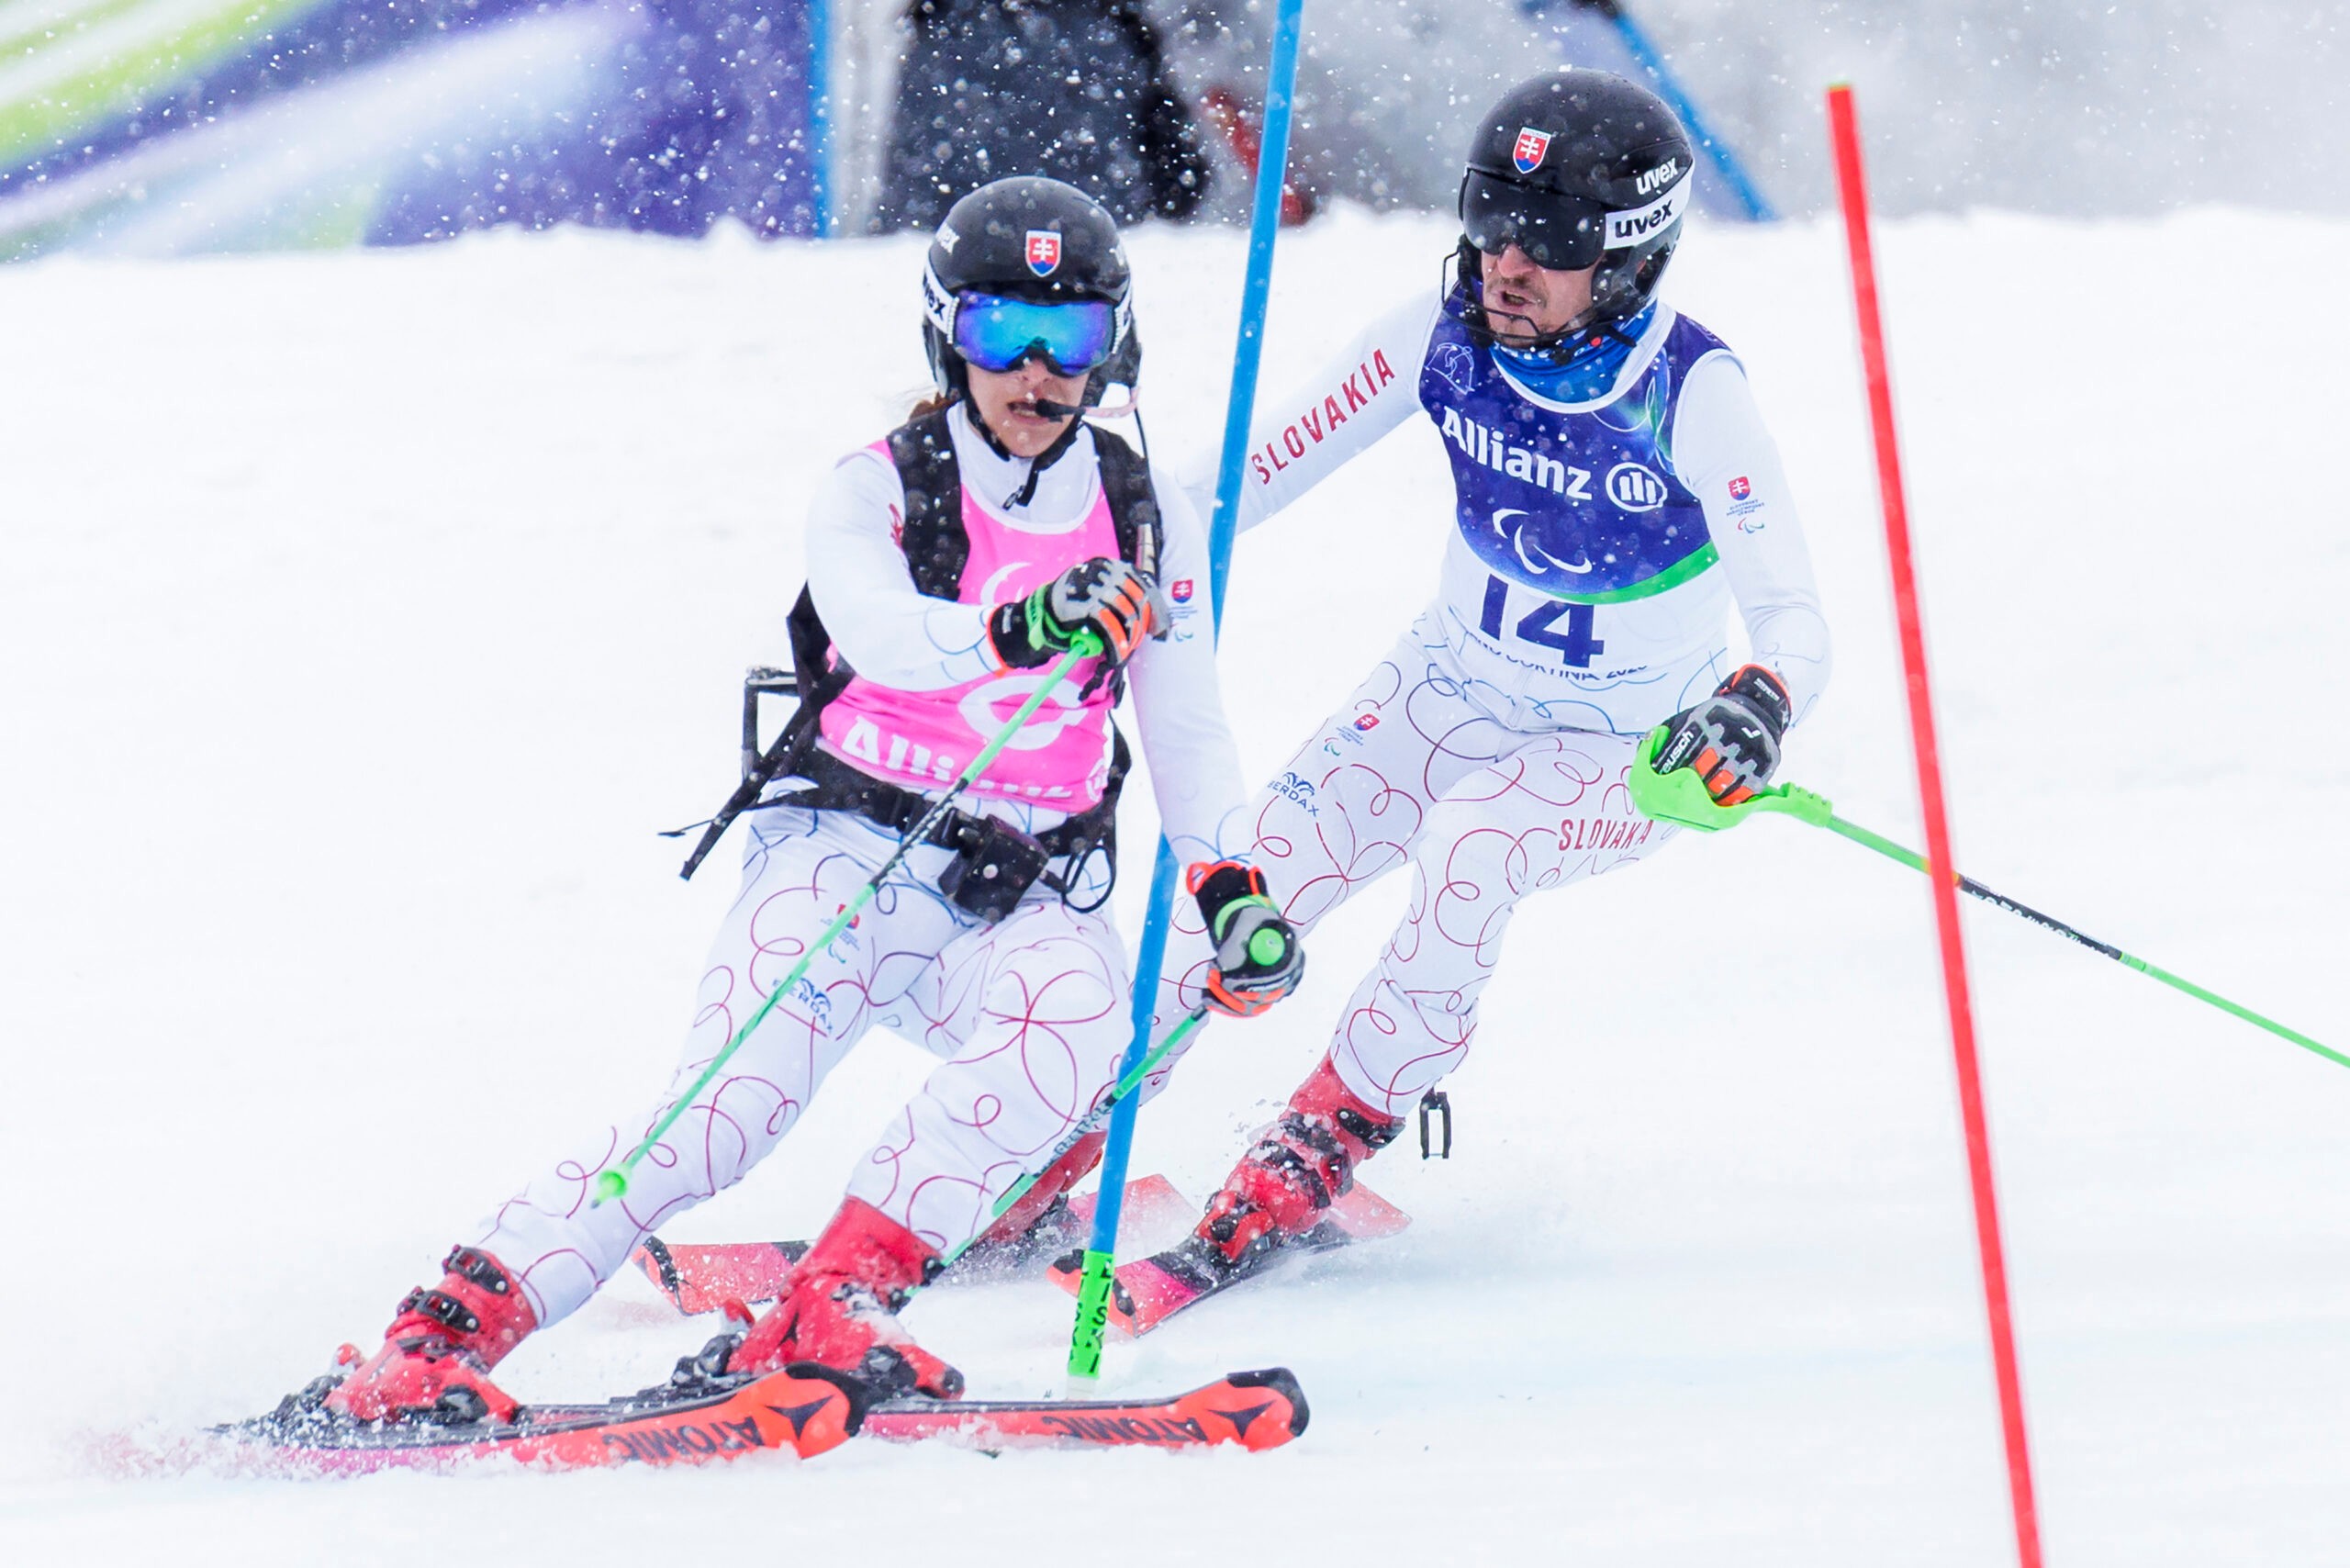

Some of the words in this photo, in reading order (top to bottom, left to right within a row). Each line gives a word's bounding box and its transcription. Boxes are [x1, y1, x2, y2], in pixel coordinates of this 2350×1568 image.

[1636, 157, 1679, 196] uvex
[1614, 198, 1673, 239] uvex
[1251, 348, 1395, 485] SLOVAKIA
[1440, 405, 1593, 500] Allianz
[1479, 574, 1605, 667] 14
[601, 1416, 766, 1462] ATOMIC
[1042, 1415, 1208, 1442] ATOMIC
